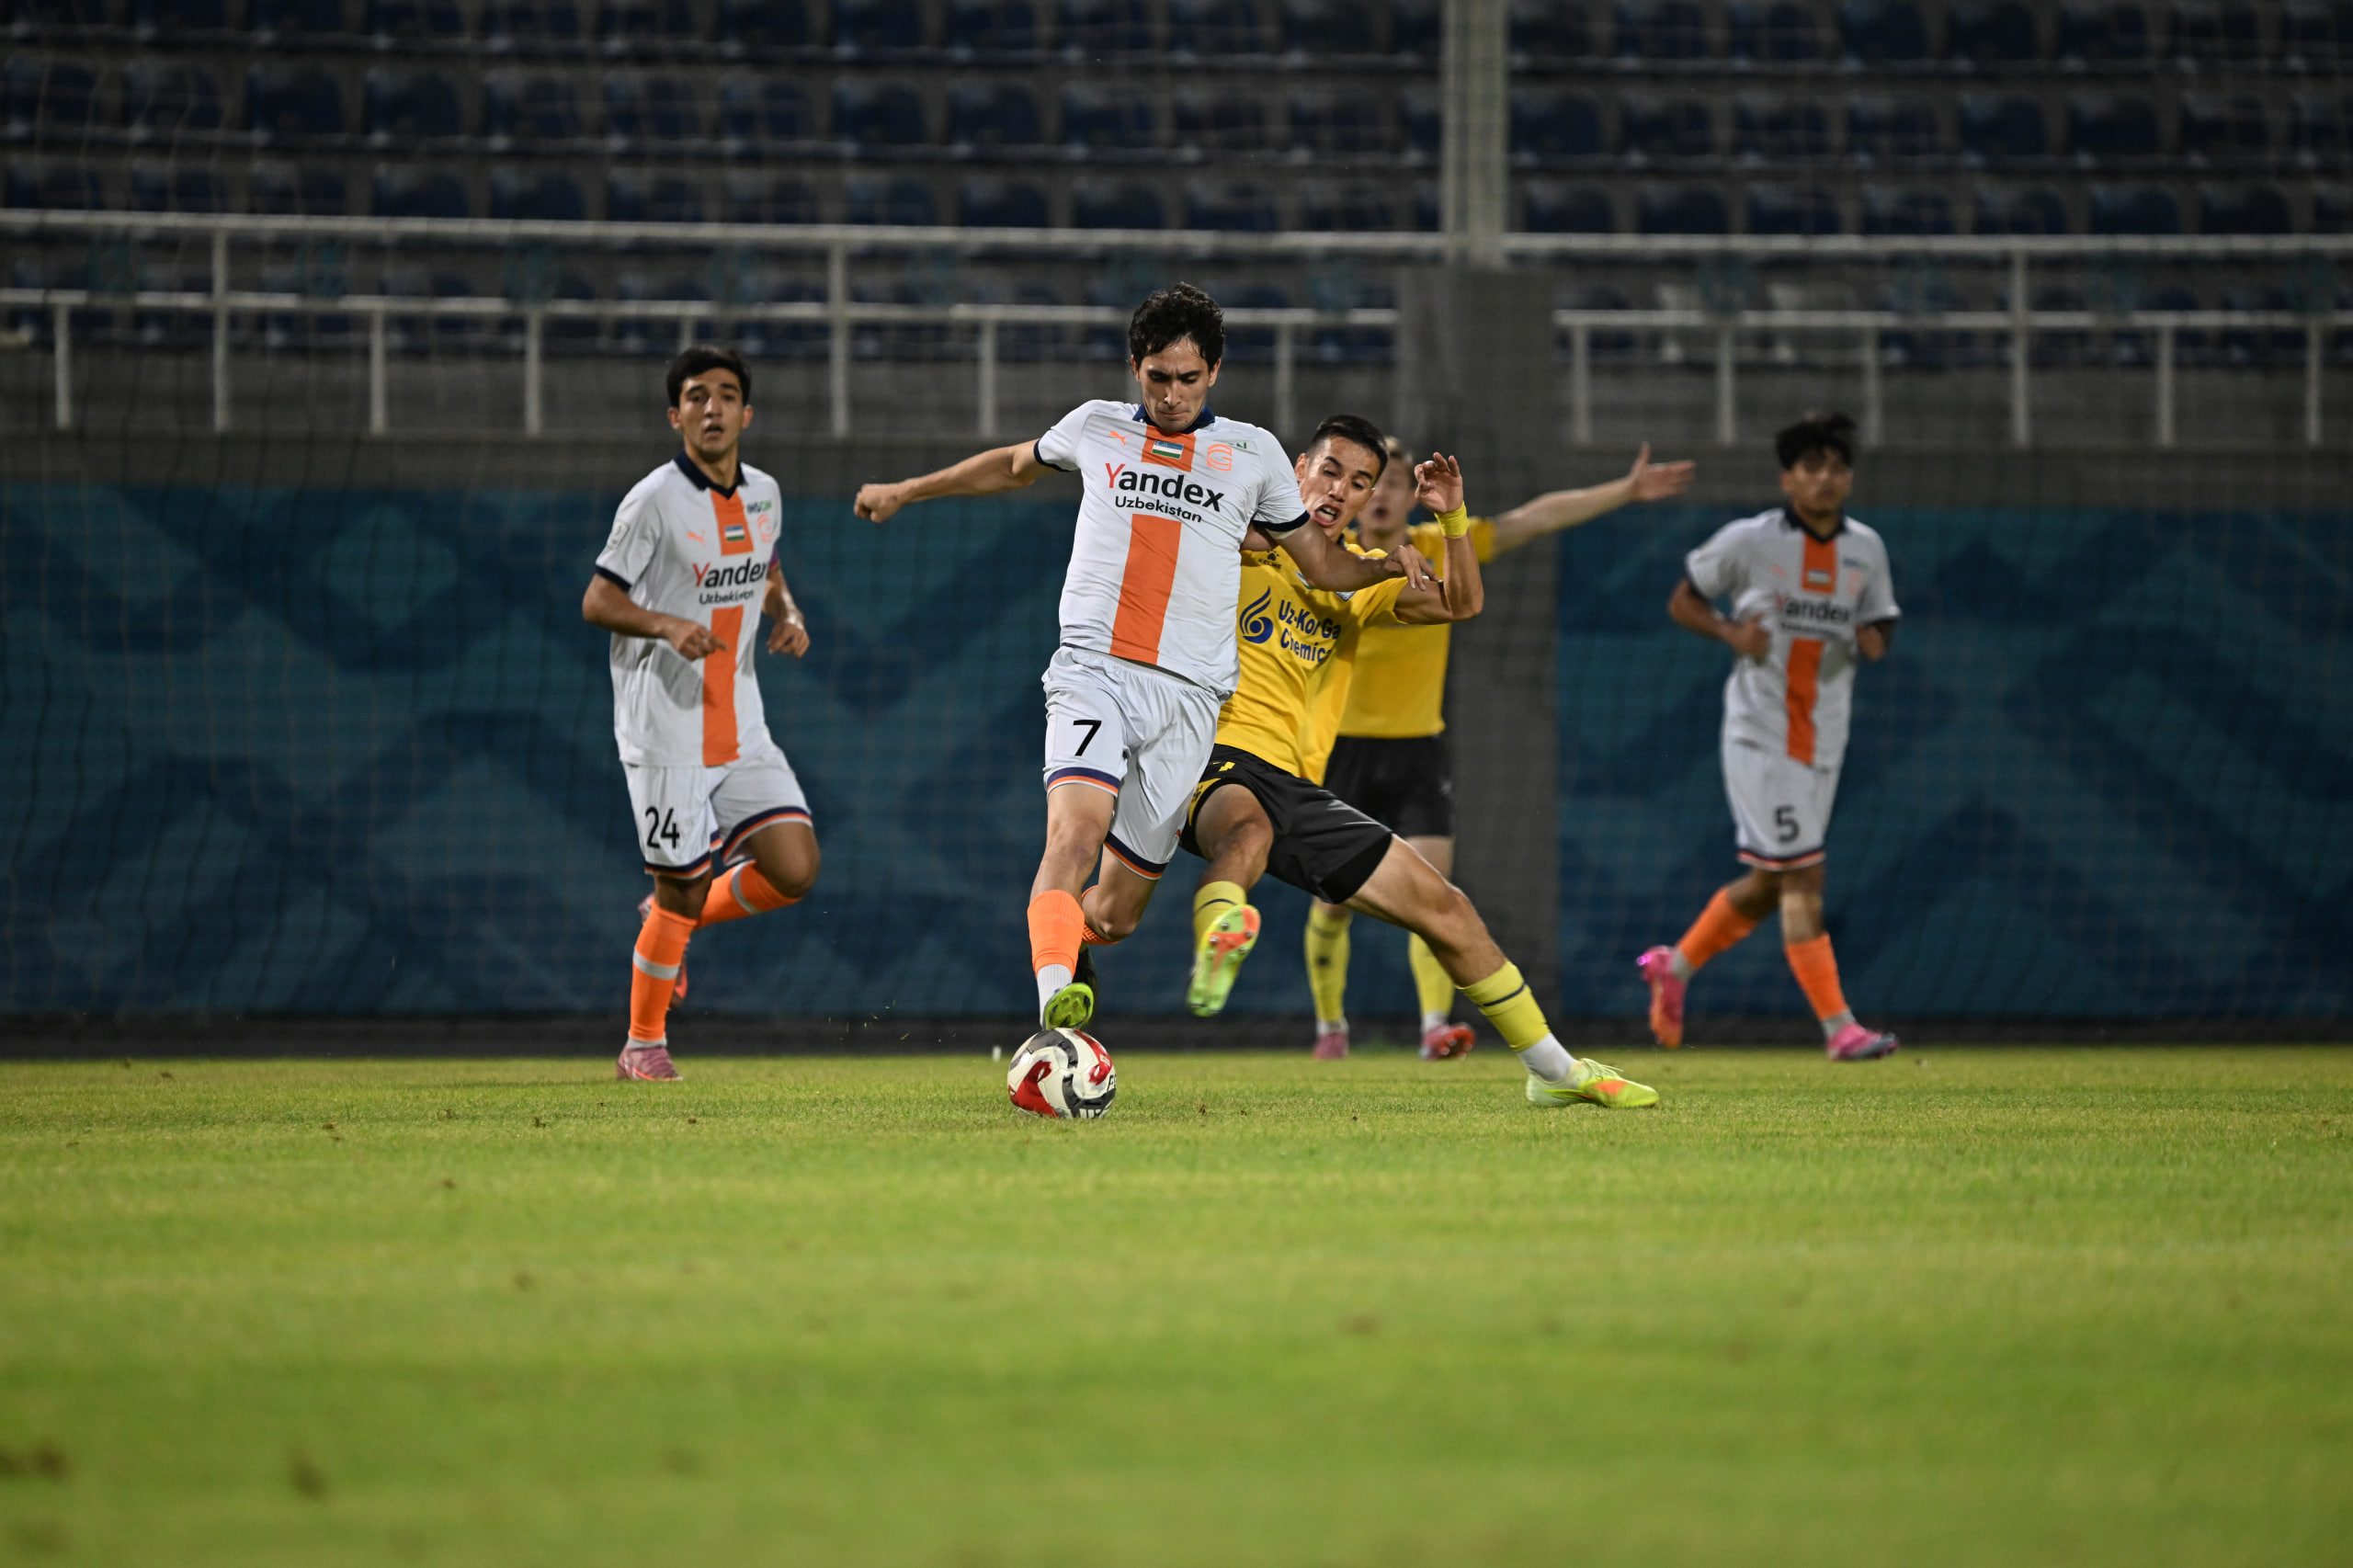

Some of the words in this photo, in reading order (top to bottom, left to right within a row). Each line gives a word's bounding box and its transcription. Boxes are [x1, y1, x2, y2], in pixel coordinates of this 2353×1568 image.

[1105, 462, 1225, 513] Yandex
[1115, 495, 1202, 523] Uzbekistan
[1072, 719, 1102, 756] 7
[644, 805, 680, 850] 24
[1775, 805, 1801, 844] 5
